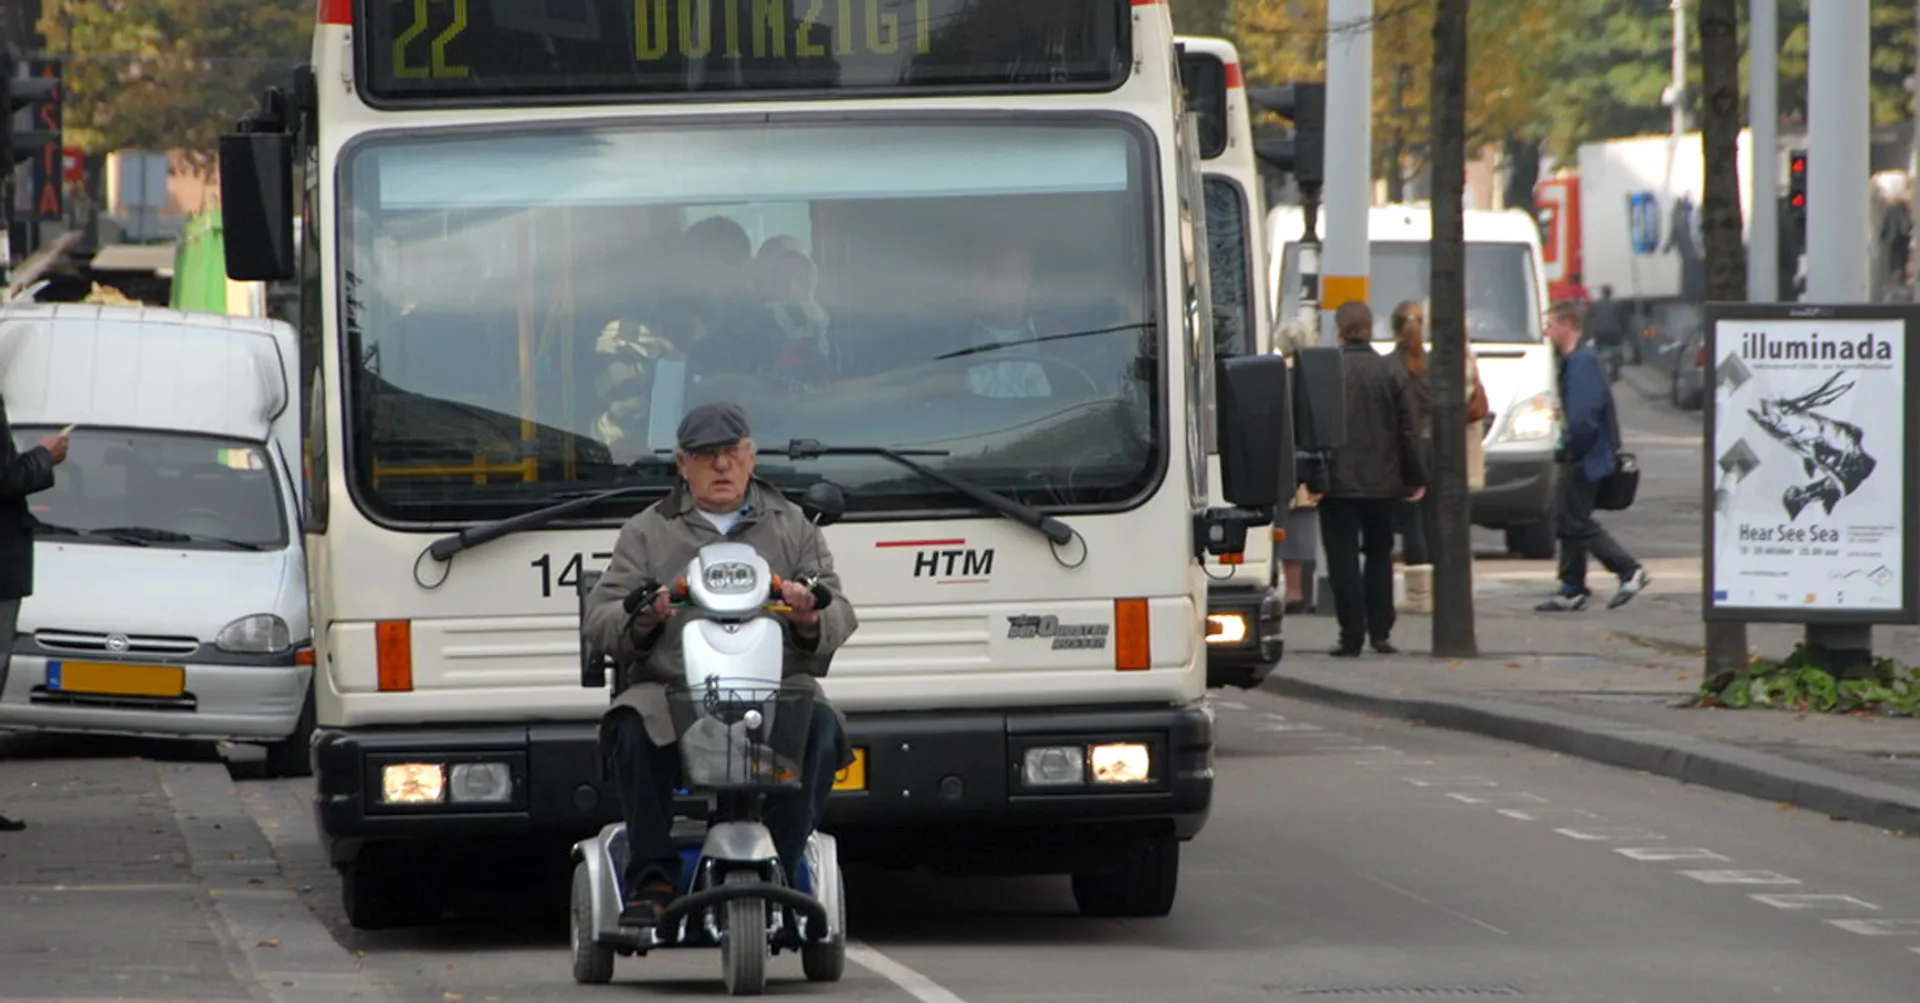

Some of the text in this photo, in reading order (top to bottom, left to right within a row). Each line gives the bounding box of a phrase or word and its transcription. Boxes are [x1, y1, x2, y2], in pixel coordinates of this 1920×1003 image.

[392, 0, 469, 78] 22
[1742, 332, 1892, 360] illuminada
[1739, 523, 1839, 542] Hear See Sea
[913, 548, 995, 577] HTM
